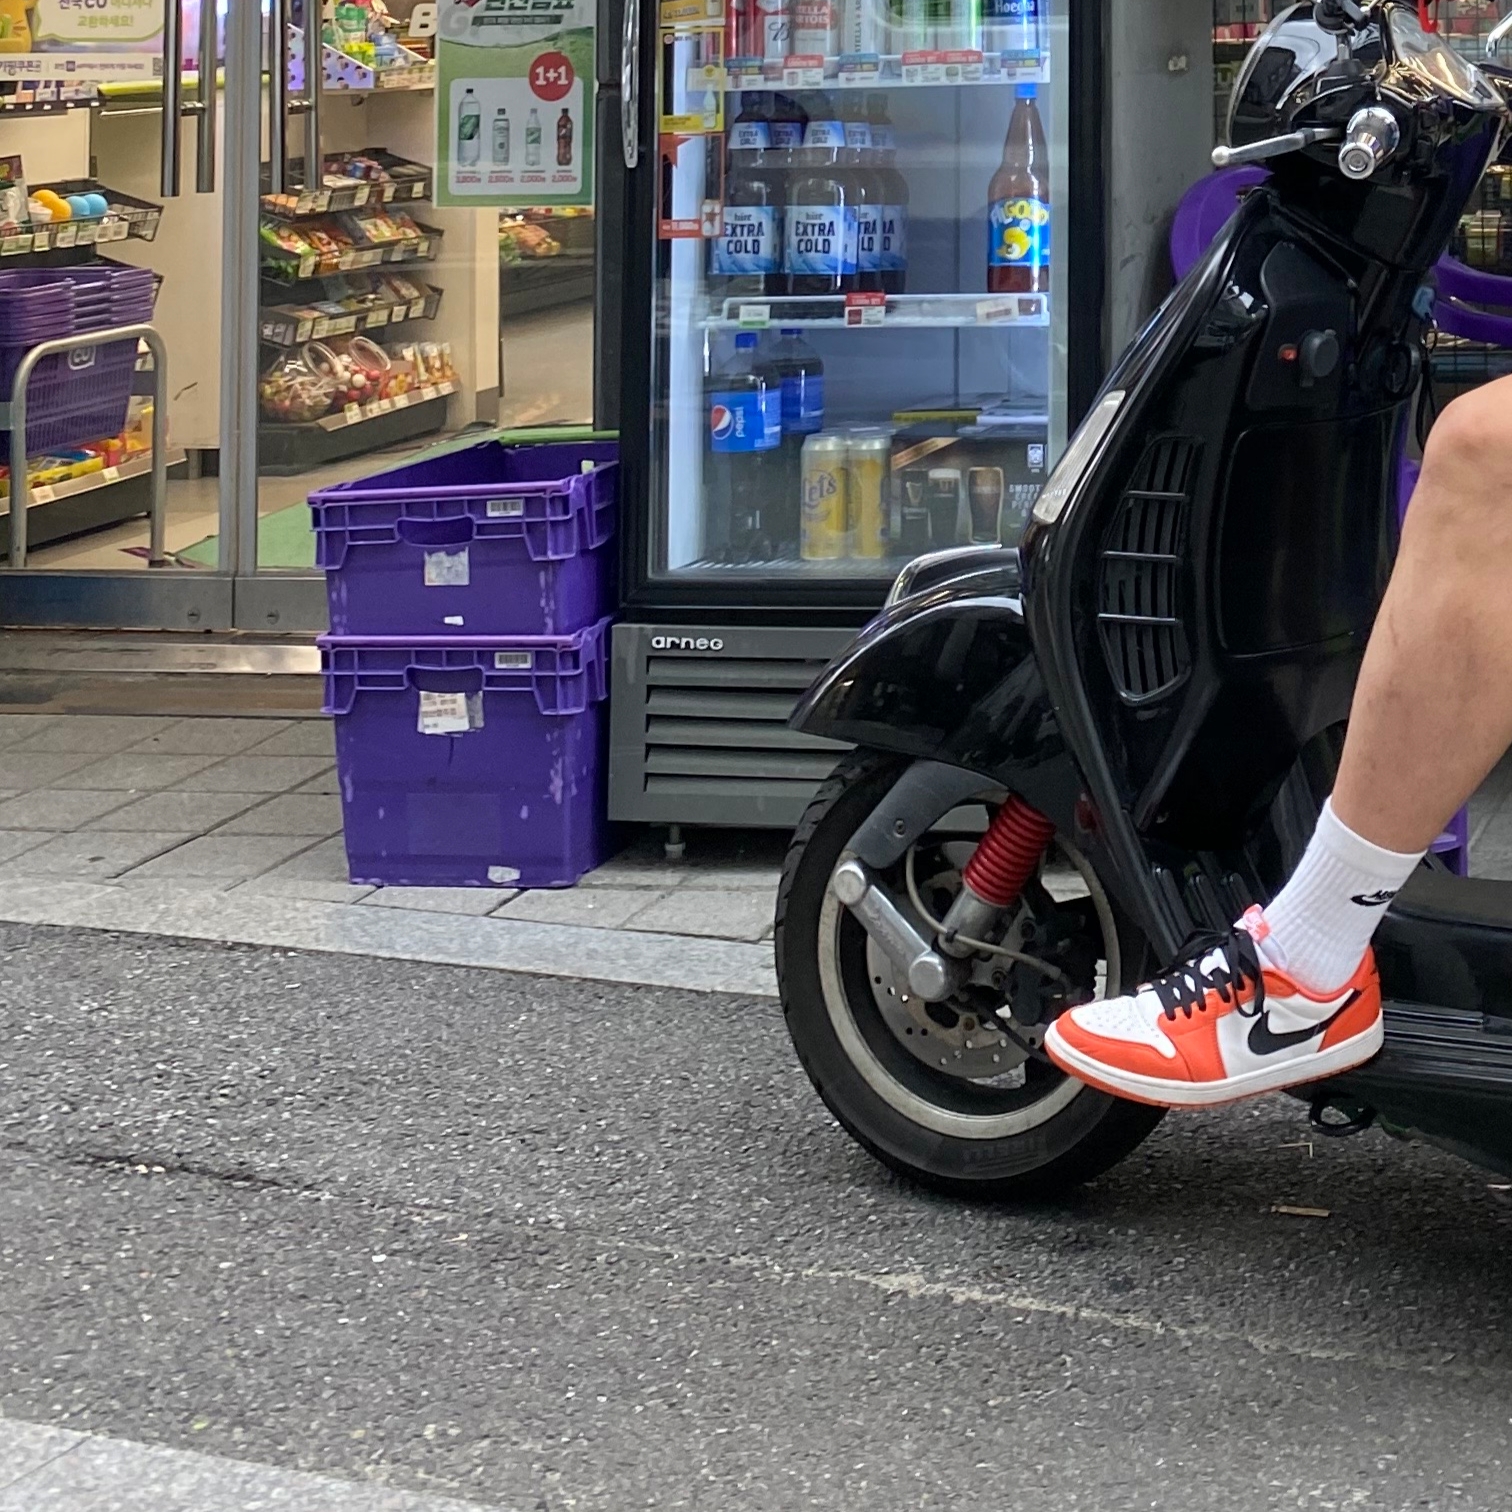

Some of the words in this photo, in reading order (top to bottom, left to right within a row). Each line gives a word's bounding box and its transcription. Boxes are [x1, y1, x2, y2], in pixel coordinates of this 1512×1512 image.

[535, 65, 569, 86] 1+1
[724, 221, 765, 238] EXTRA
[795, 221, 836, 237] EXTRA
[726, 239, 761, 255] COLD
[797, 239, 831, 254] COLD
[734, 406, 746, 438] pepsi
